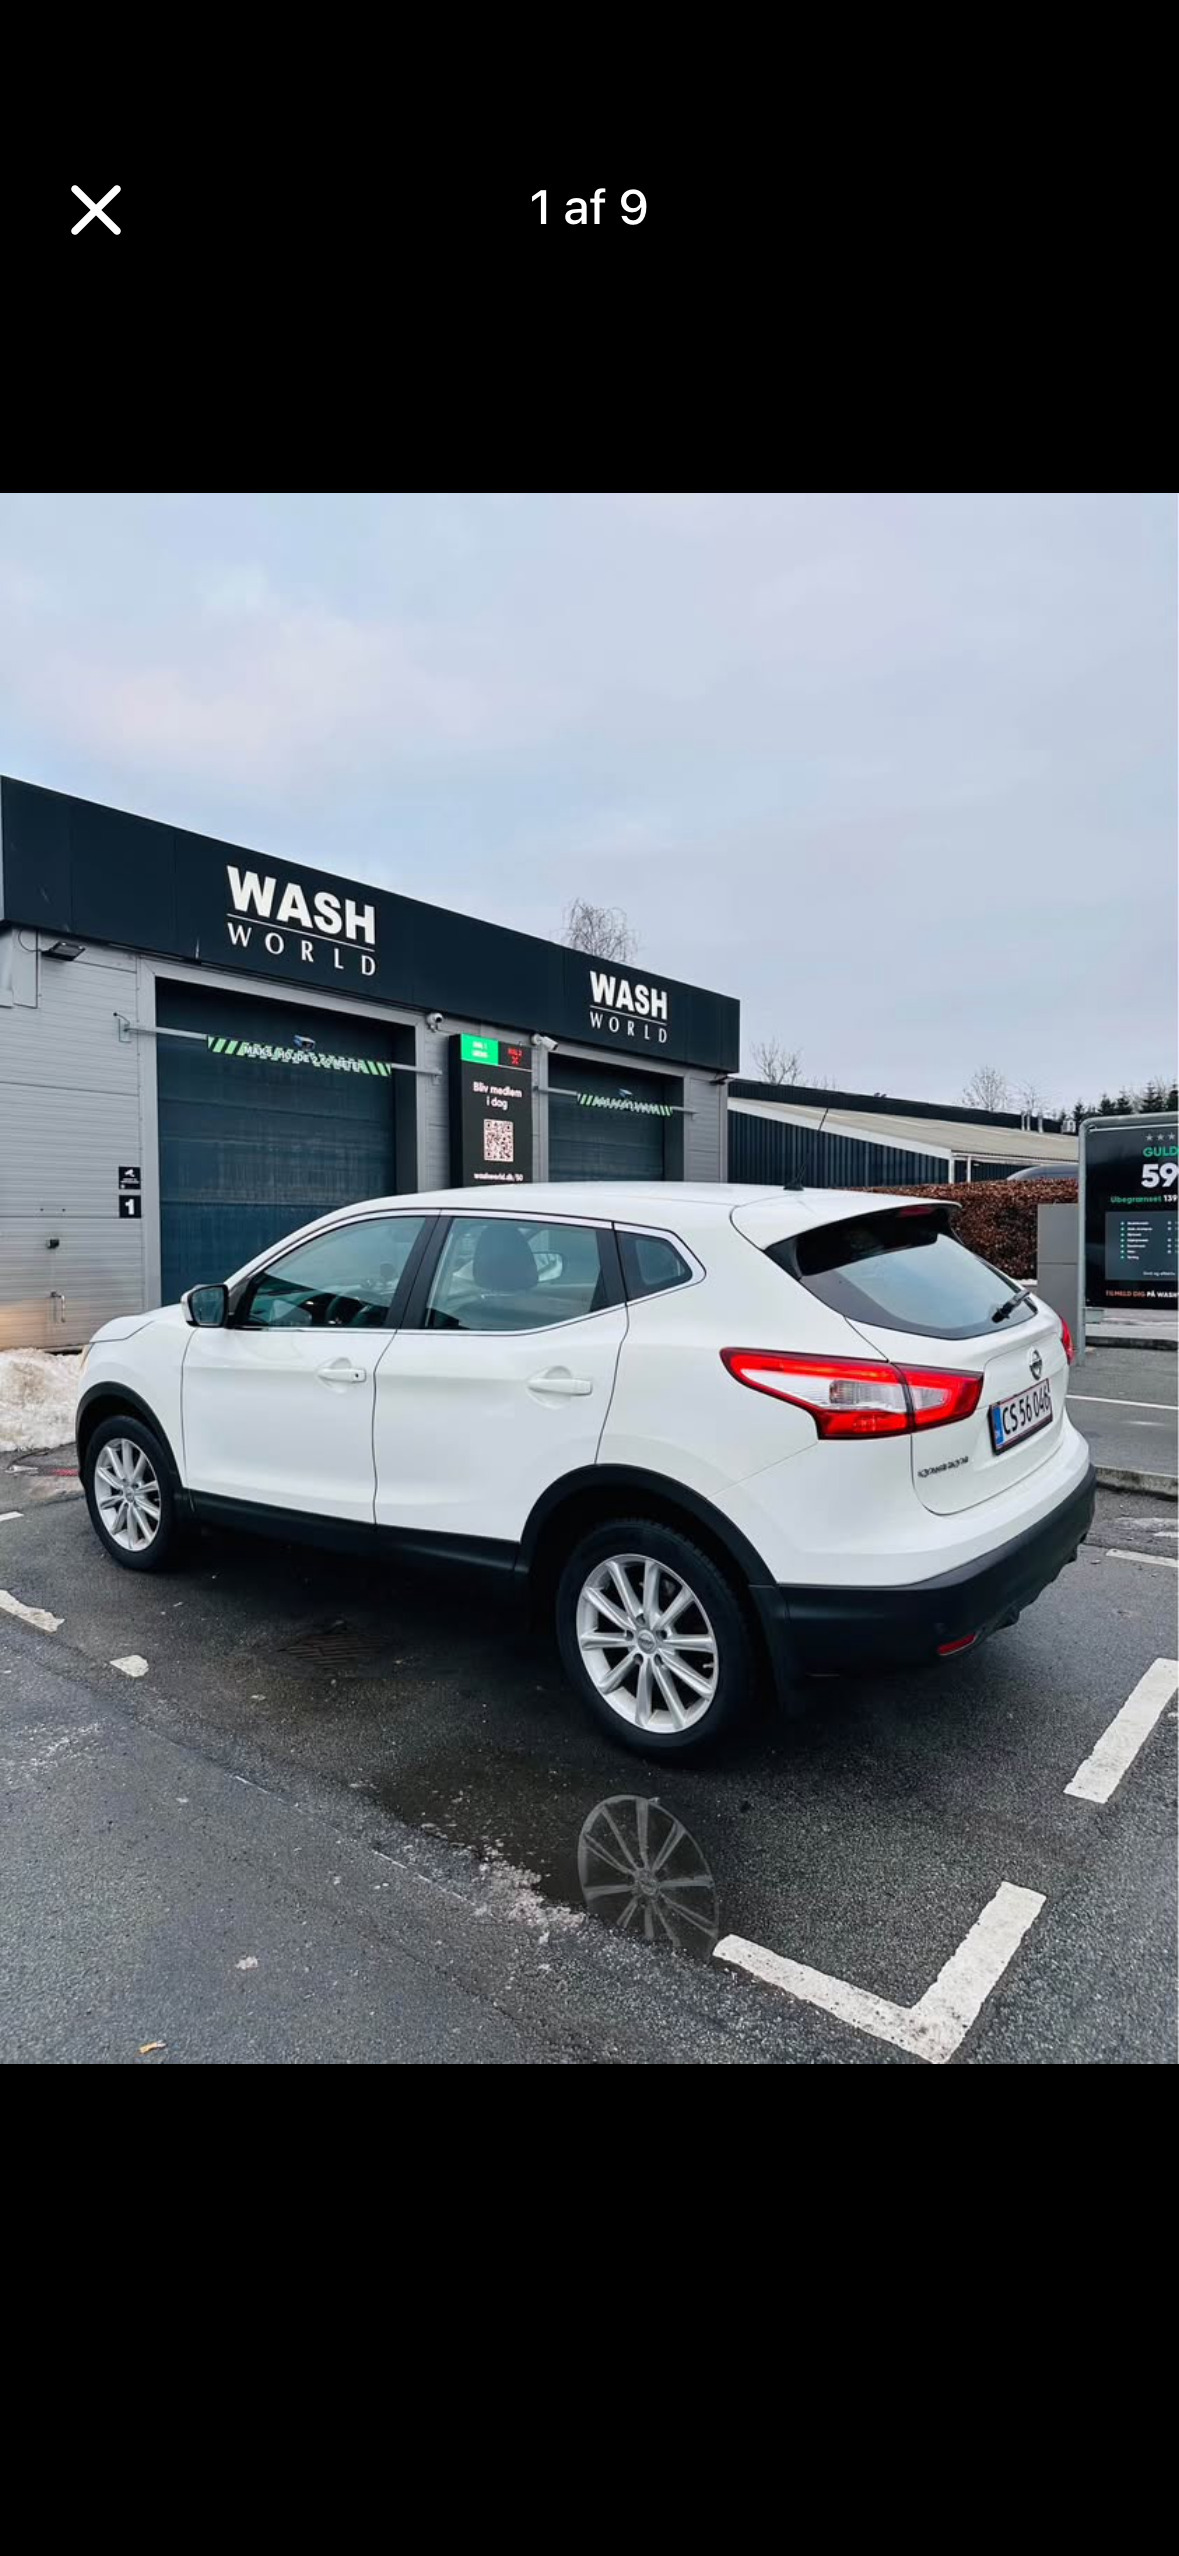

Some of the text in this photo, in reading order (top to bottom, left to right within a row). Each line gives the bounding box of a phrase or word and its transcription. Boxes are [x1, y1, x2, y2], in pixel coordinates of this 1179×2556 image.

[227, 865, 376, 945] WASH
[227, 922, 376, 976] WORLD
[589, 970, 668, 1020] WASH
[589, 1011, 668, 1043] WORLD
[473, 1081, 523, 1098] Bliv medlem
[486, 1095, 490, 1106] i
[1143, 1146, 1178, 1157] GULD
[1141, 1162, 1178, 1188] 59
[125, 1198, 135, 1216] 1
[1146, 1289, 1156, 1298] PÅ
[1002, 1384, 1050, 1435] CS 56 046
